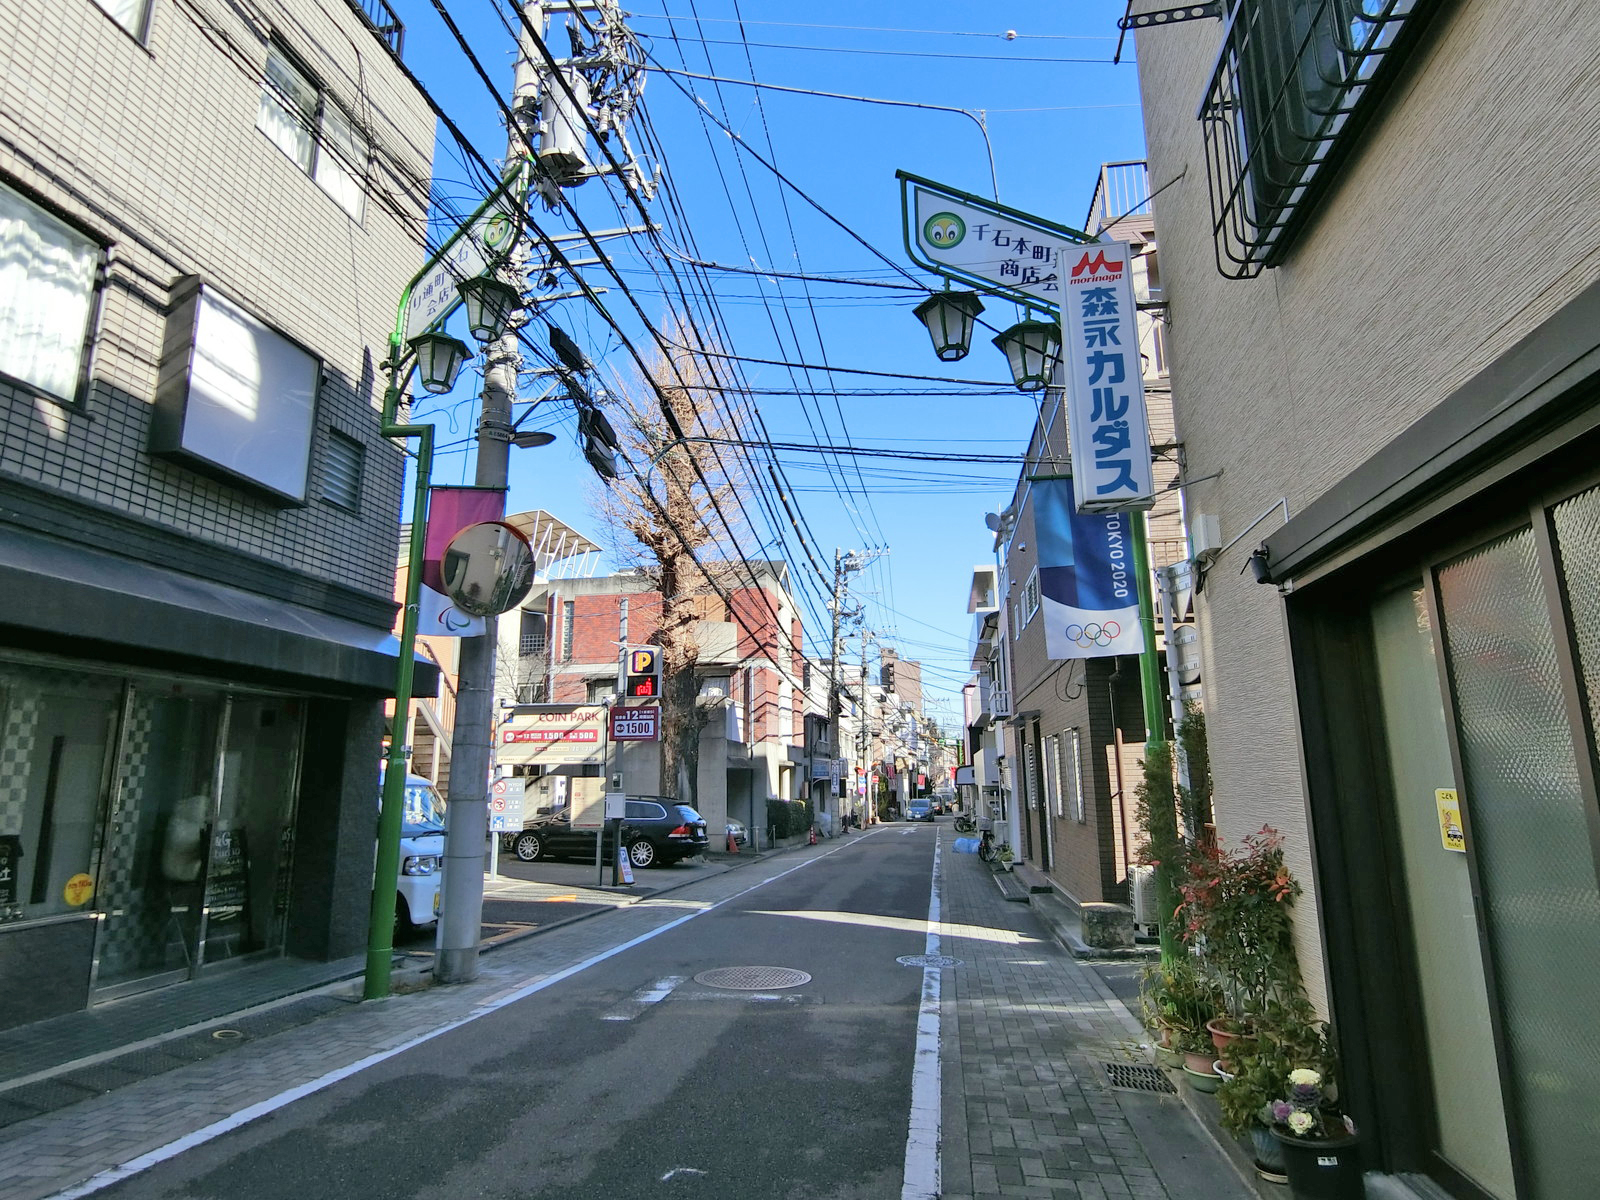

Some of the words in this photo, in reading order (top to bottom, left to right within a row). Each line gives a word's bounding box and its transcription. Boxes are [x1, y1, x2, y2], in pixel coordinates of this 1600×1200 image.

[971, 223, 1058, 268] 千石本町
[1070, 273, 1122, 285] morinaga
[1081, 286, 1139, 495] 森永カルダス
[1106, 512, 1124, 560] TOKYO
[1111, 562, 1129, 598] 2020
[636, 652, 652, 672] P
[539, 712, 568, 722] COIN
[570, 711, 599, 722] PARK
